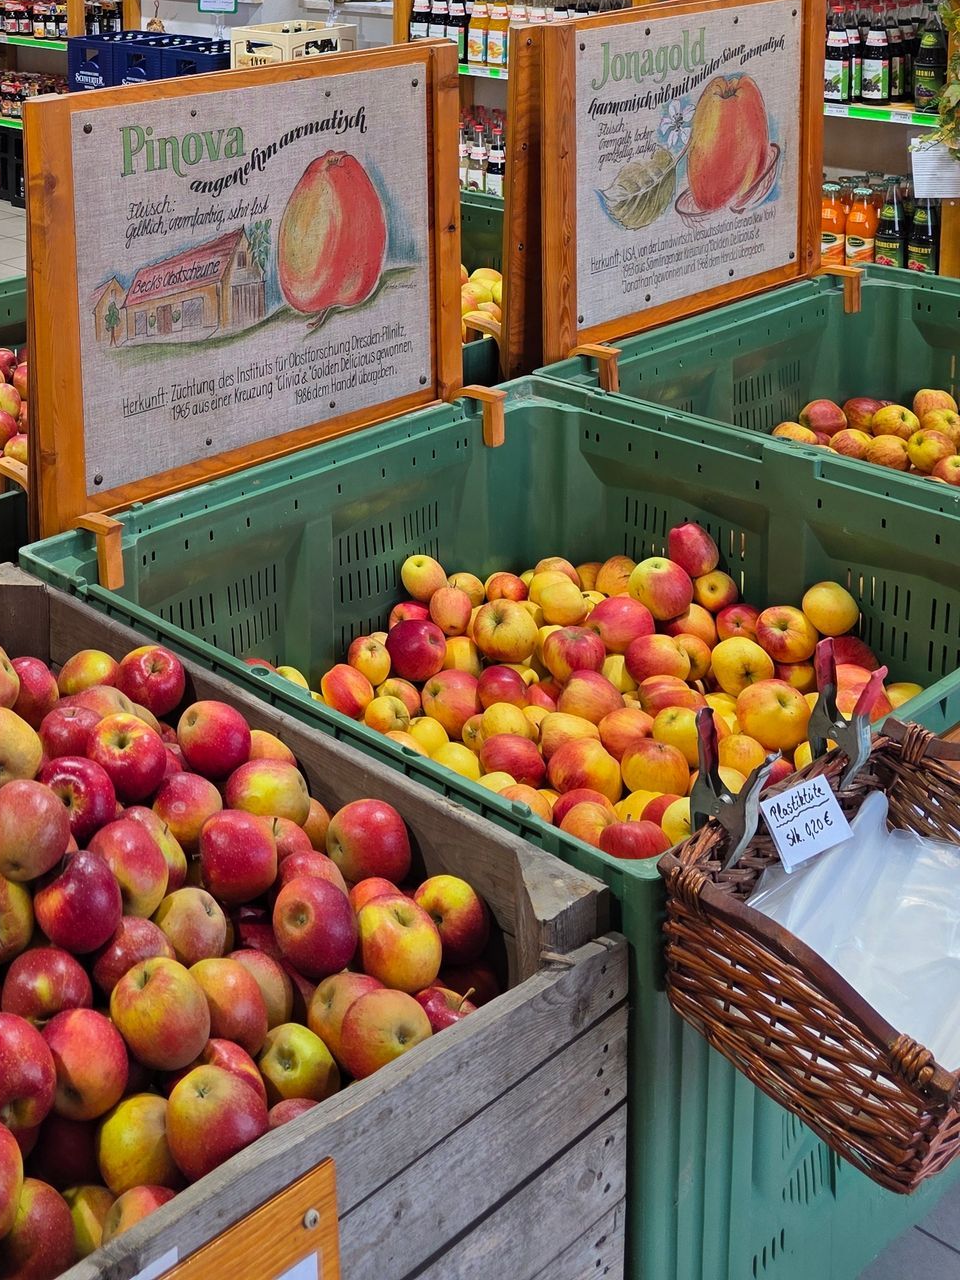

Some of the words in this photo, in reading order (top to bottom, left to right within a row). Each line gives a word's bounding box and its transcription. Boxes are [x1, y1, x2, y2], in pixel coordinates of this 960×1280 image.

[591, 26, 705, 90] Jonagold
[739, 34, 785, 66] aromatisch
[587, 90, 652, 121] harmonisch
[690, 54, 722, 90] milder
[118, 124, 247, 178] Pinova
[190, 147, 278, 198] angenehm
[278, 105, 368, 150] aromatisch
[126, 194, 176, 221] Fleisch:
[227, 198, 251, 221] sehr
[250, 193, 270, 221] fest
[590, 249, 621, 273] Herkunft:
[122, 387, 169, 417] Herkunft:
[170, 377, 216, 402] Züchtung
[218, 370, 235, 389] des
[236, 359, 273, 384] Instituts
[274, 355, 288, 373] für
[288, 339, 351, 370] Obstforschung
[171, 402, 192, 421] 1965
[192, 400, 210, 416] aus
[210, 393, 233, 410] einer
[234, 382, 274, 405] Kreuzung
[301, 371, 309, 385] &
[340, 351, 376, 371] Delicious
[376, 340, 414, 363] gewonnen,
[294, 385, 312, 405] 1986
[312, 382, 331, 400] dem
[331, 372, 358, 393] Handel
[358, 364, 398, 385] übergeben.
[769, 783, 826, 823] Plastiktüte
